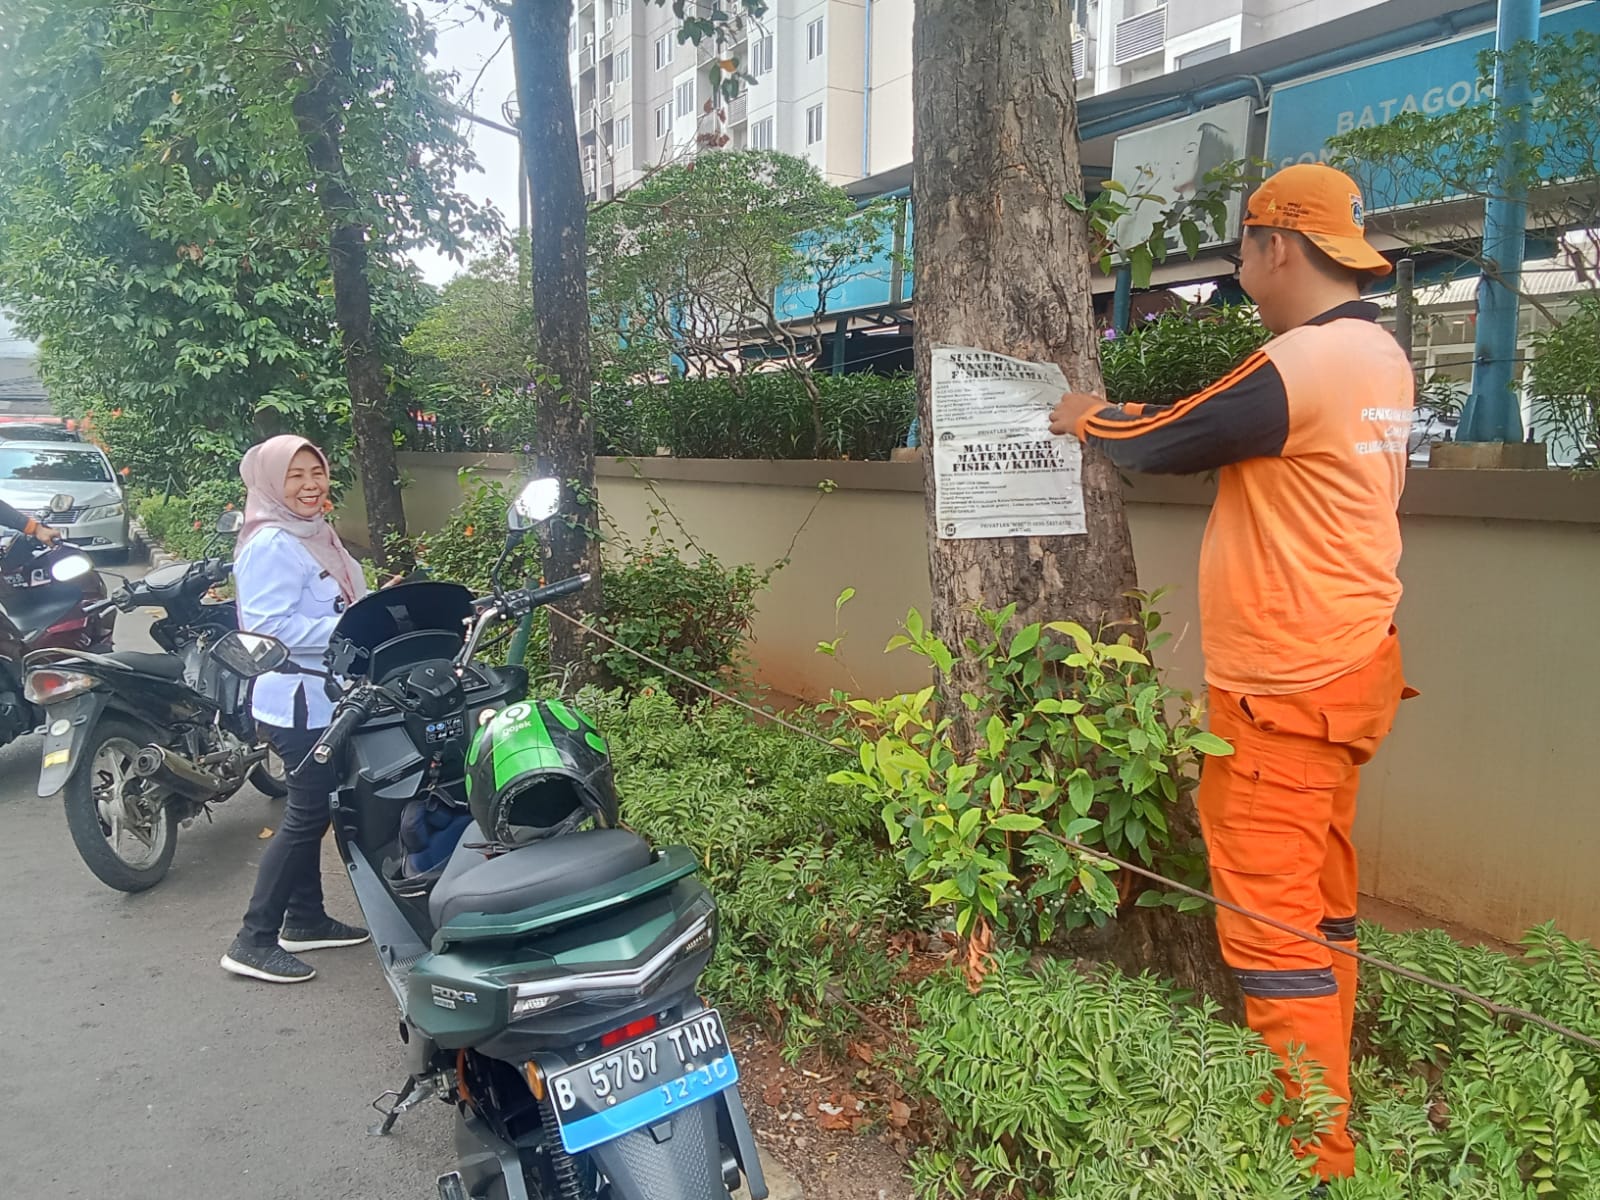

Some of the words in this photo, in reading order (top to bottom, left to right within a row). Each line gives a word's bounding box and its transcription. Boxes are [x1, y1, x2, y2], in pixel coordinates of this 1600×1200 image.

[963, 444, 992, 453] MAU
[997, 440, 1052, 451] PINTAR
[952, 461, 1002, 472] FISIKA
[502, 720, 532, 737] gojek
[554, 1078, 576, 1111] B
[588, 1041, 657, 1097] 5767
[668, 1016, 722, 1062] TWR
